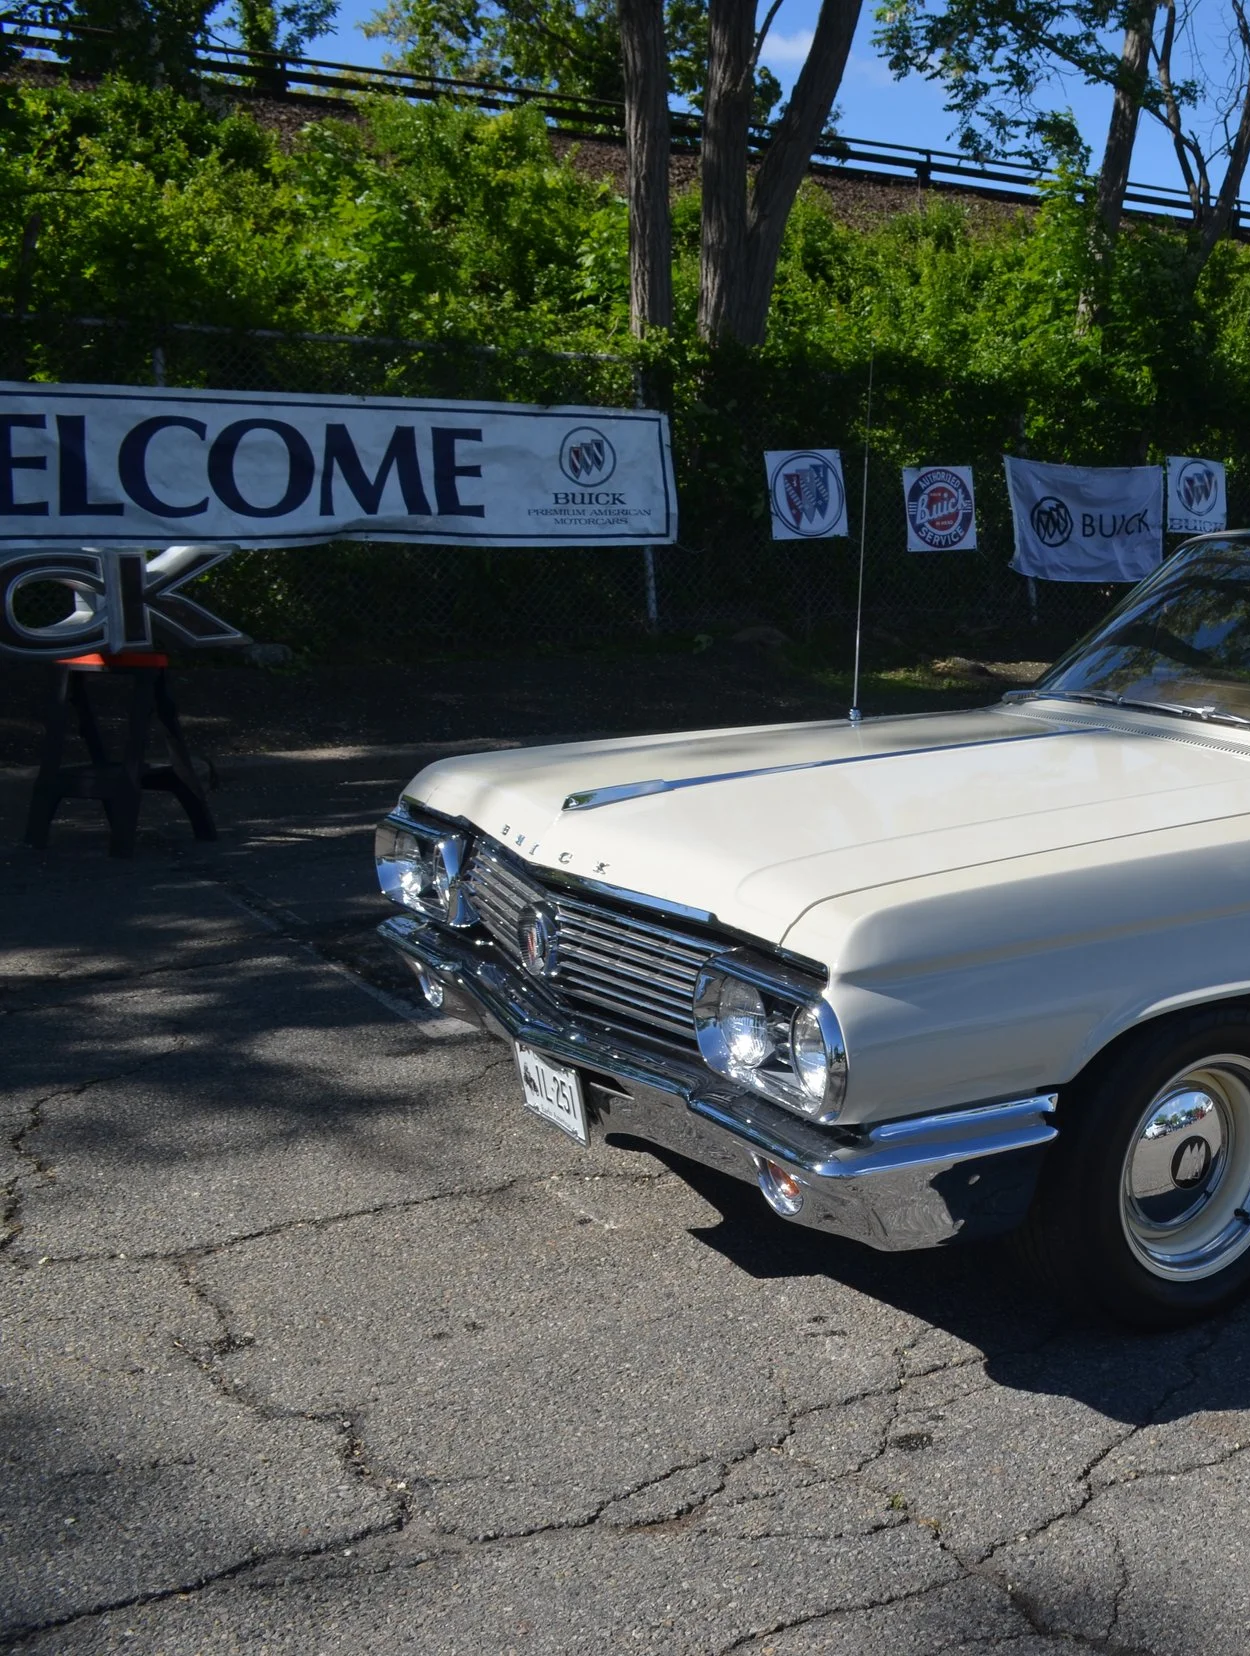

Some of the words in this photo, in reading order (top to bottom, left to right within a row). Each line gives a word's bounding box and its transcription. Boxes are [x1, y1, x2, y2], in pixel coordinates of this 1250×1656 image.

[919, 471, 961, 490] AUTHORIZED
[552, 492, 627, 505] BUICK
[916, 488, 968, 524] Buick
[527, 508, 586, 516] PREMIUM
[589, 508, 652, 516] AMERICAN
[1082, 509, 1150, 538] BUICK
[1168, 518, 1225, 532] BUICK
[919, 527, 964, 546] SERVICE
[501, 824, 610, 875] BUICK
